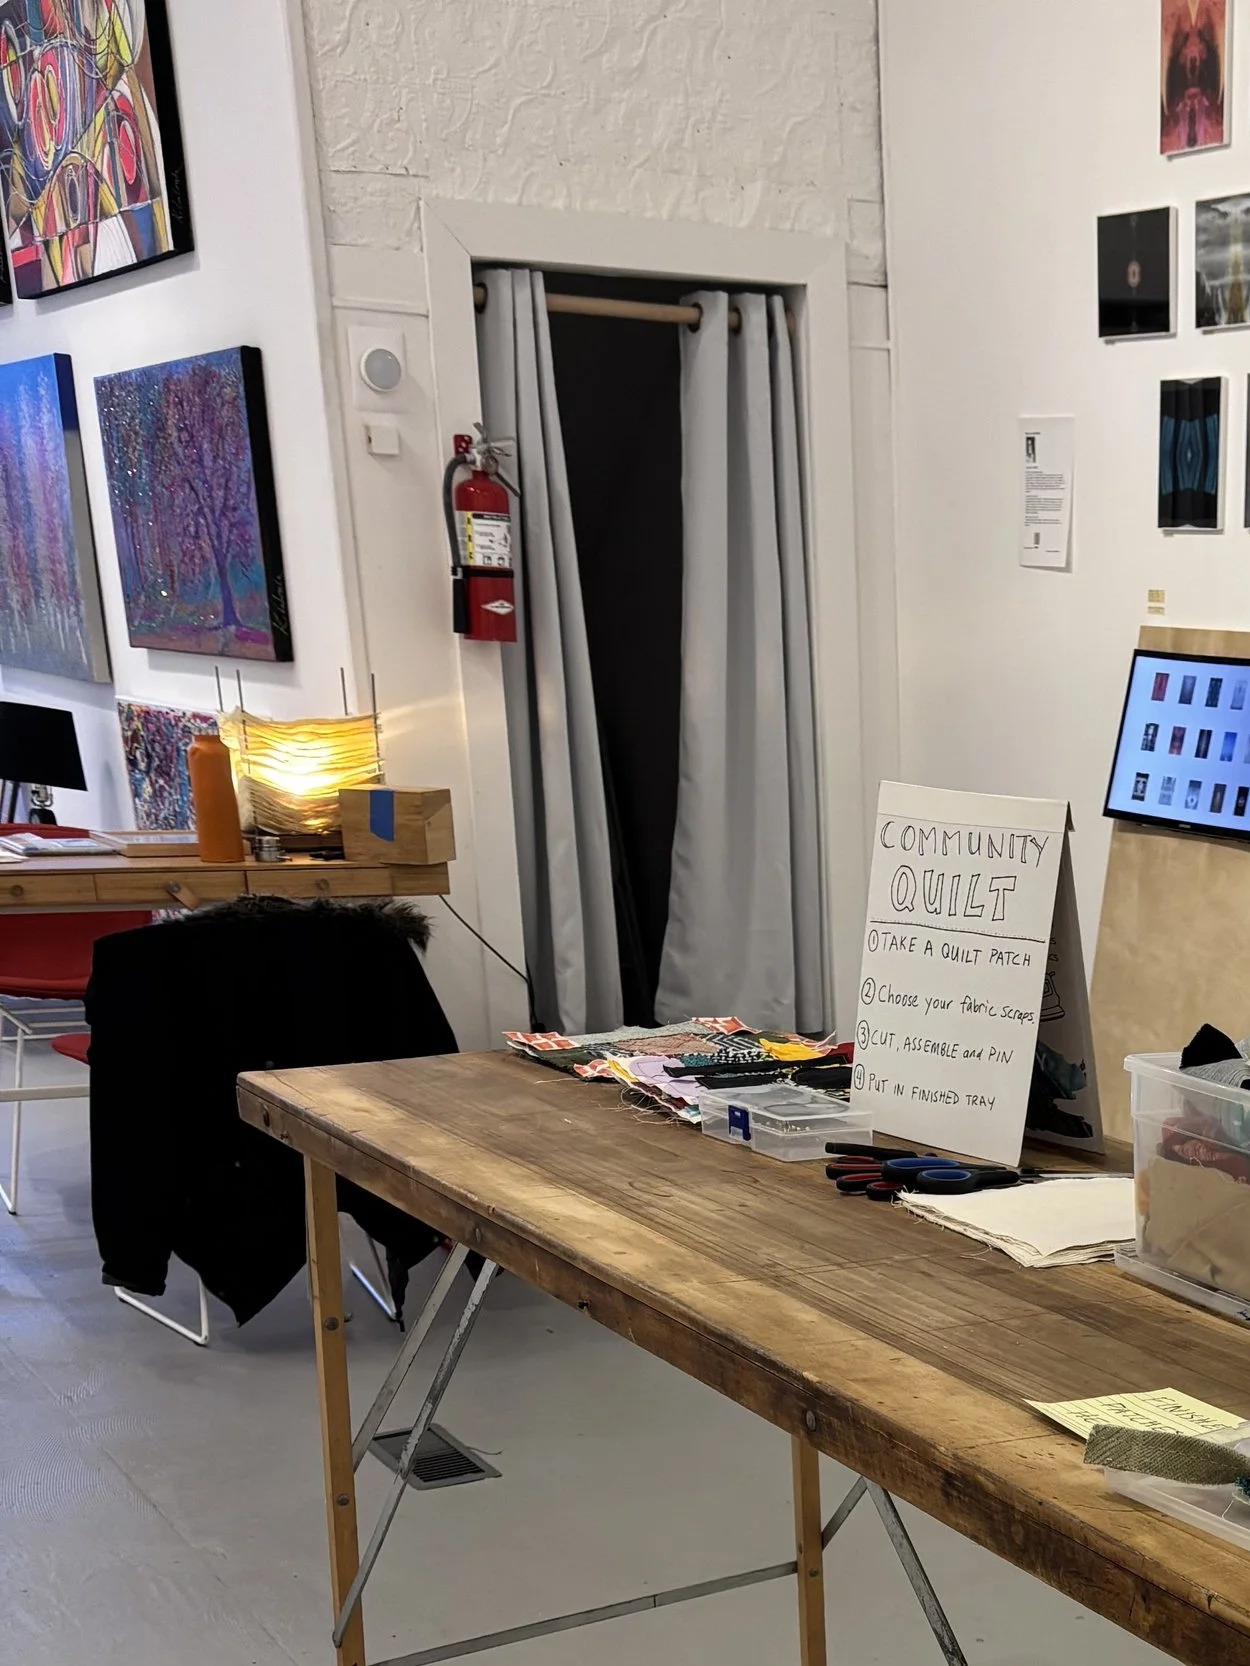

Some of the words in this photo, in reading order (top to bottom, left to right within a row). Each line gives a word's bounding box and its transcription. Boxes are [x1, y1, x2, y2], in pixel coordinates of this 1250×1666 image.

[880, 821, 1049, 868] COMMUNITY
[891, 865, 1017, 921] QUILT
[881, 932, 917, 952] TAKE
[924, 939, 933, 957] A
[941, 943, 982, 965] QUILT
[989, 949, 1031, 966] PATCH
[878, 983, 919, 1007] Choose
[925, 997, 954, 1015] your
[960, 995, 997, 1017] fabric
[871, 1029, 900, 1052] CUT,
[904, 1036, 960, 1059] ASSEMBLE
[963, 1048, 983, 1060] and
[988, 1047, 1013, 1064] PIN
[893, 1083, 905, 1096] IN
[911, 1086, 960, 1105] FINISHED
[965, 1094, 996, 1111] TRAY
[1143, 1396, 1223, 1430] FINISHE
